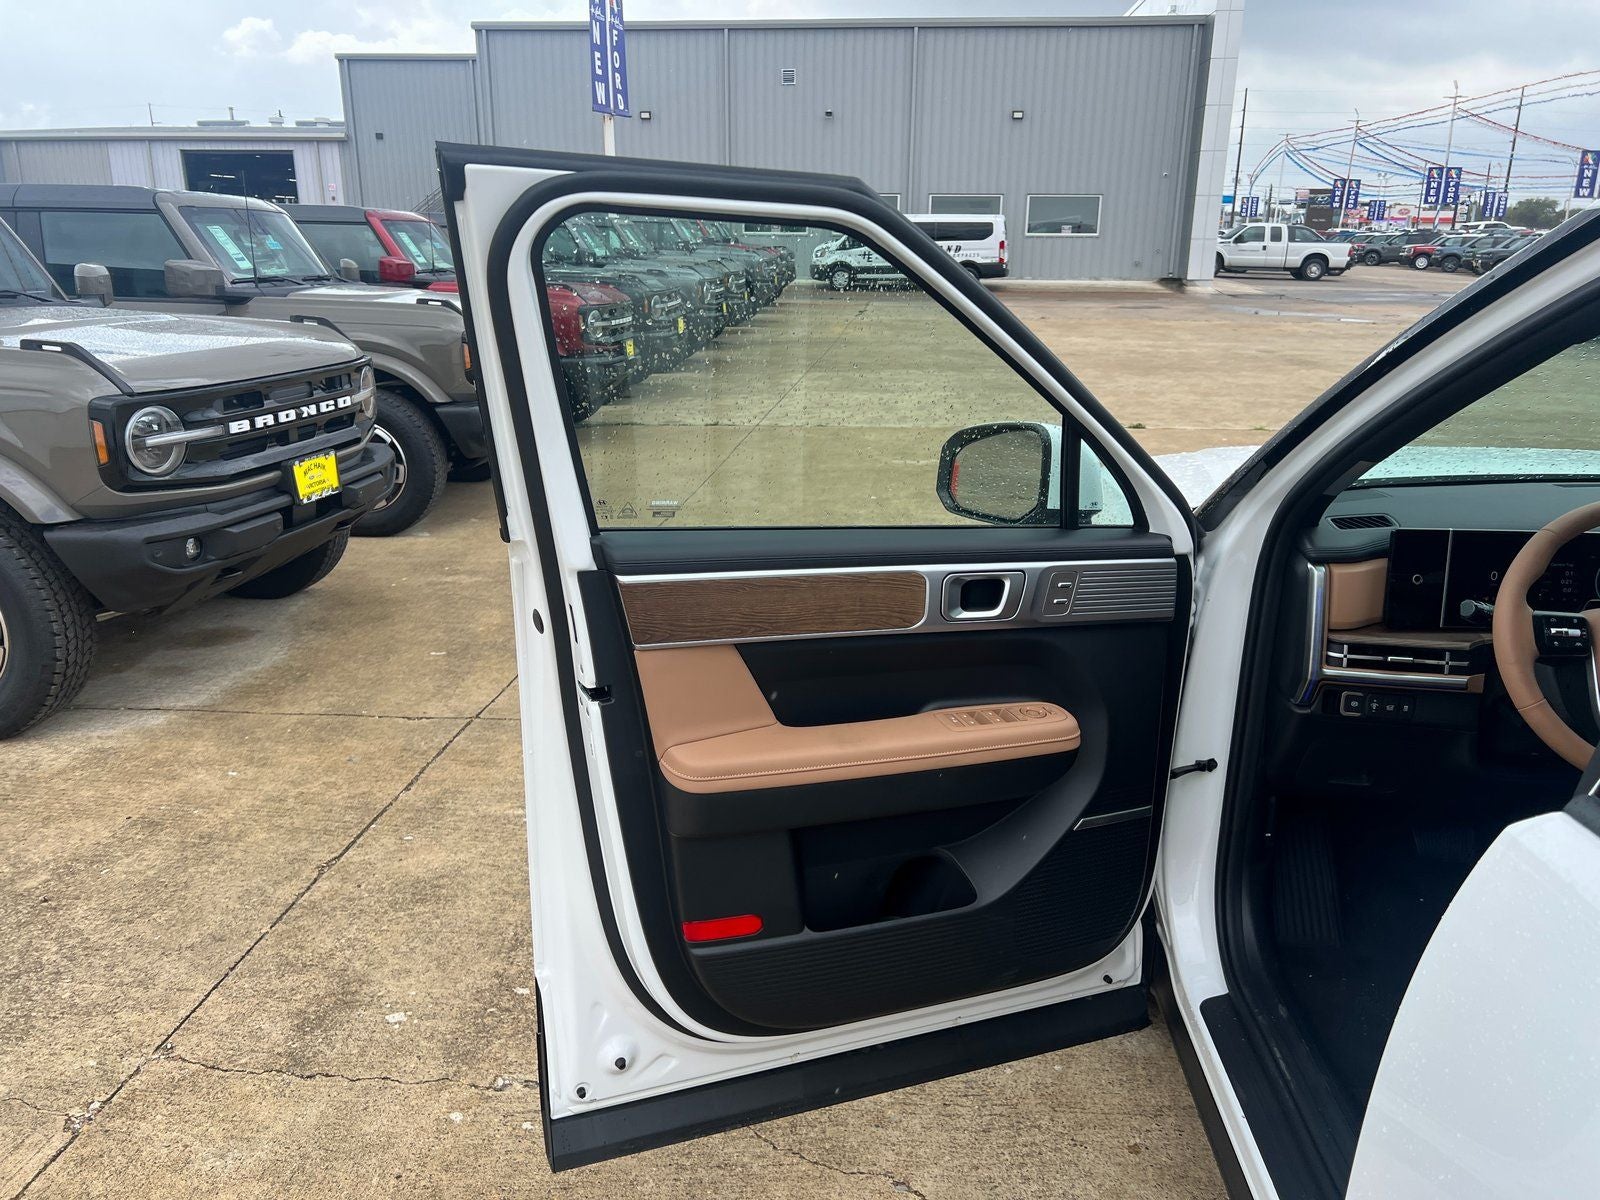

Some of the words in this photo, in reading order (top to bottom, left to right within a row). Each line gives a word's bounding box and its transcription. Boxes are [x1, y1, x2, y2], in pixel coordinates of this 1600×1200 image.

[592, 20, 606, 106] NEW
[612, 29, 625, 111] FORD
[1427, 181, 1438, 203] NEW
[1446, 181, 1457, 203] FORD
[1579, 169, 1592, 196] NEW
[1332, 190, 1342, 208] NEW
[229, 396, 352, 434] BRONCO
